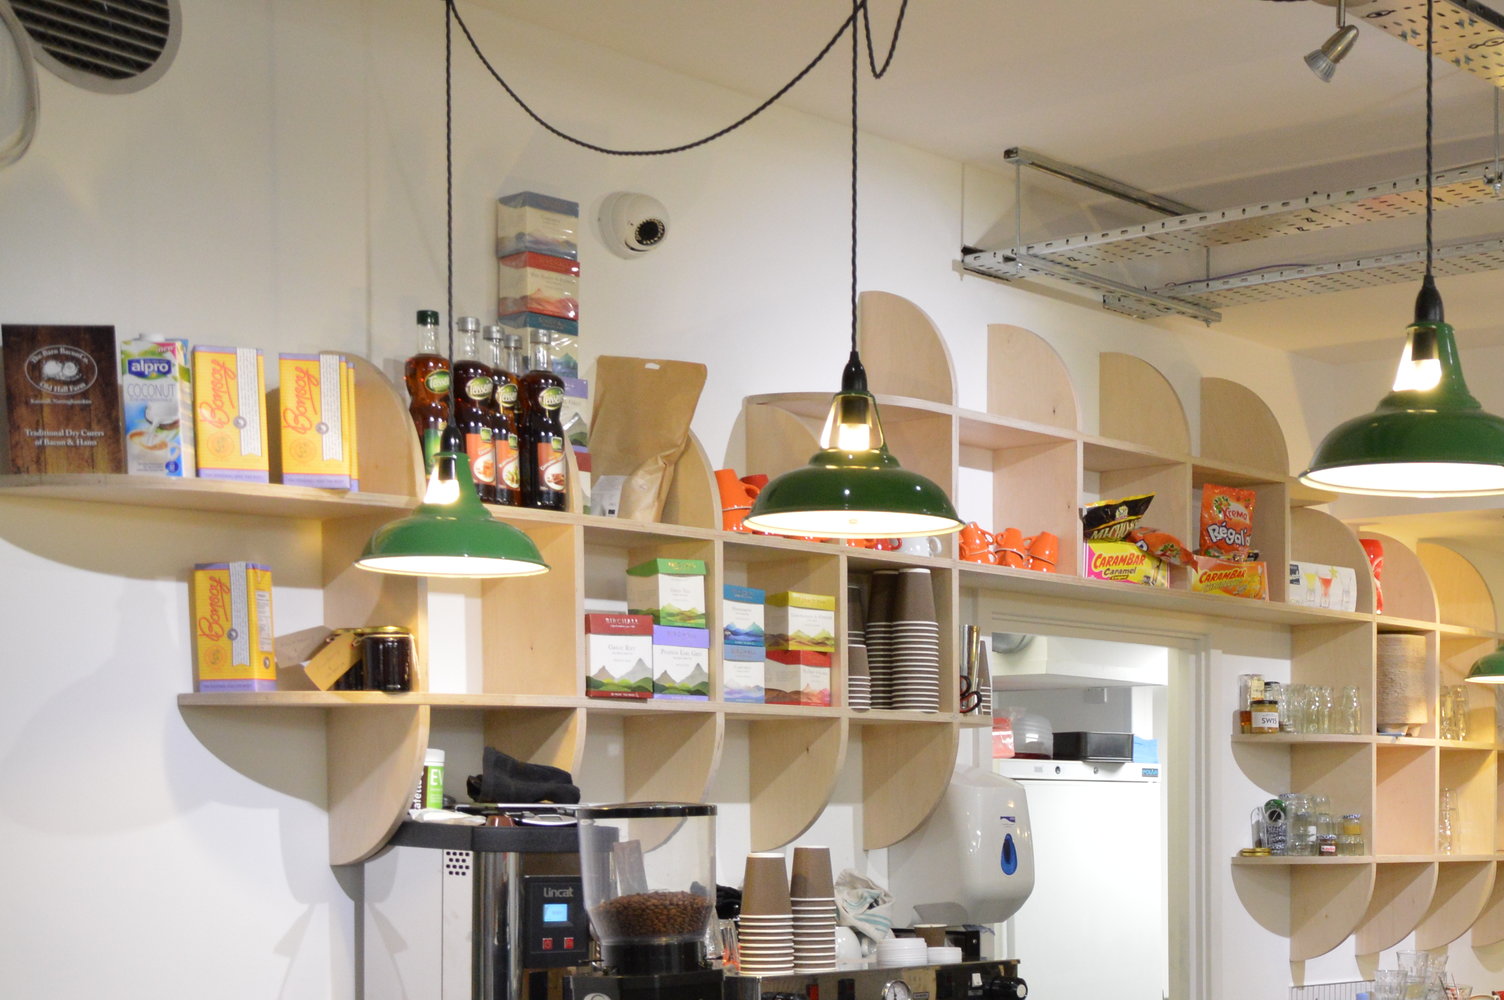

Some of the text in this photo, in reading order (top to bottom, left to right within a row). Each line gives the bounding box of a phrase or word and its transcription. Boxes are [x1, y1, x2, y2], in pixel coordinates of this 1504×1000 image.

[131, 360, 169, 375] alpro
[127, 383, 176, 398] COCONUT
[198, 360, 237, 429] Bonsoy
[281, 366, 320, 435] Bonsoy
[65, 429, 80, 438] Dry
[199, 575, 231, 642] Bonsoy
